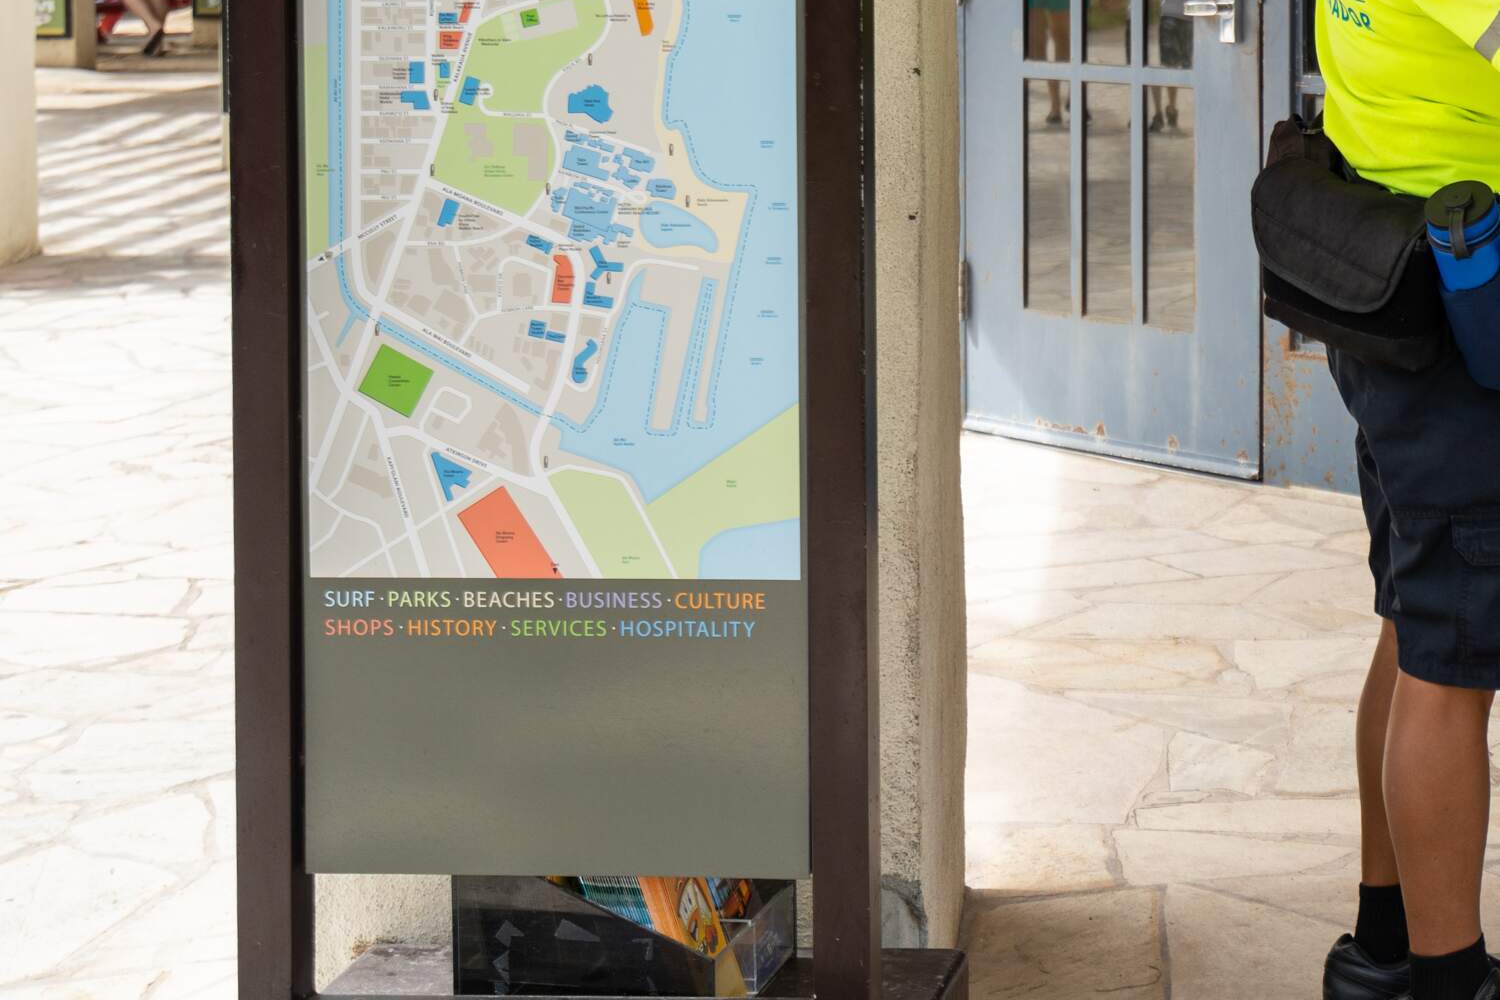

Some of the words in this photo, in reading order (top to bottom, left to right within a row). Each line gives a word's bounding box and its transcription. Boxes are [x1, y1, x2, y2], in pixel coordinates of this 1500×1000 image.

[324, 590, 375, 608] SURF
[388, 591, 452, 608] PARKS
[463, 591, 555, 609] BEACHES
[565, 591, 662, 609] BUSINESS
[674, 592, 766, 611] CULTURE
[324, 619, 395, 637] SHOPS
[407, 619, 497, 637] HISTORY
[510, 619, 607, 638] SERVICES
[619, 620, 755, 638] HOSPITALITY
